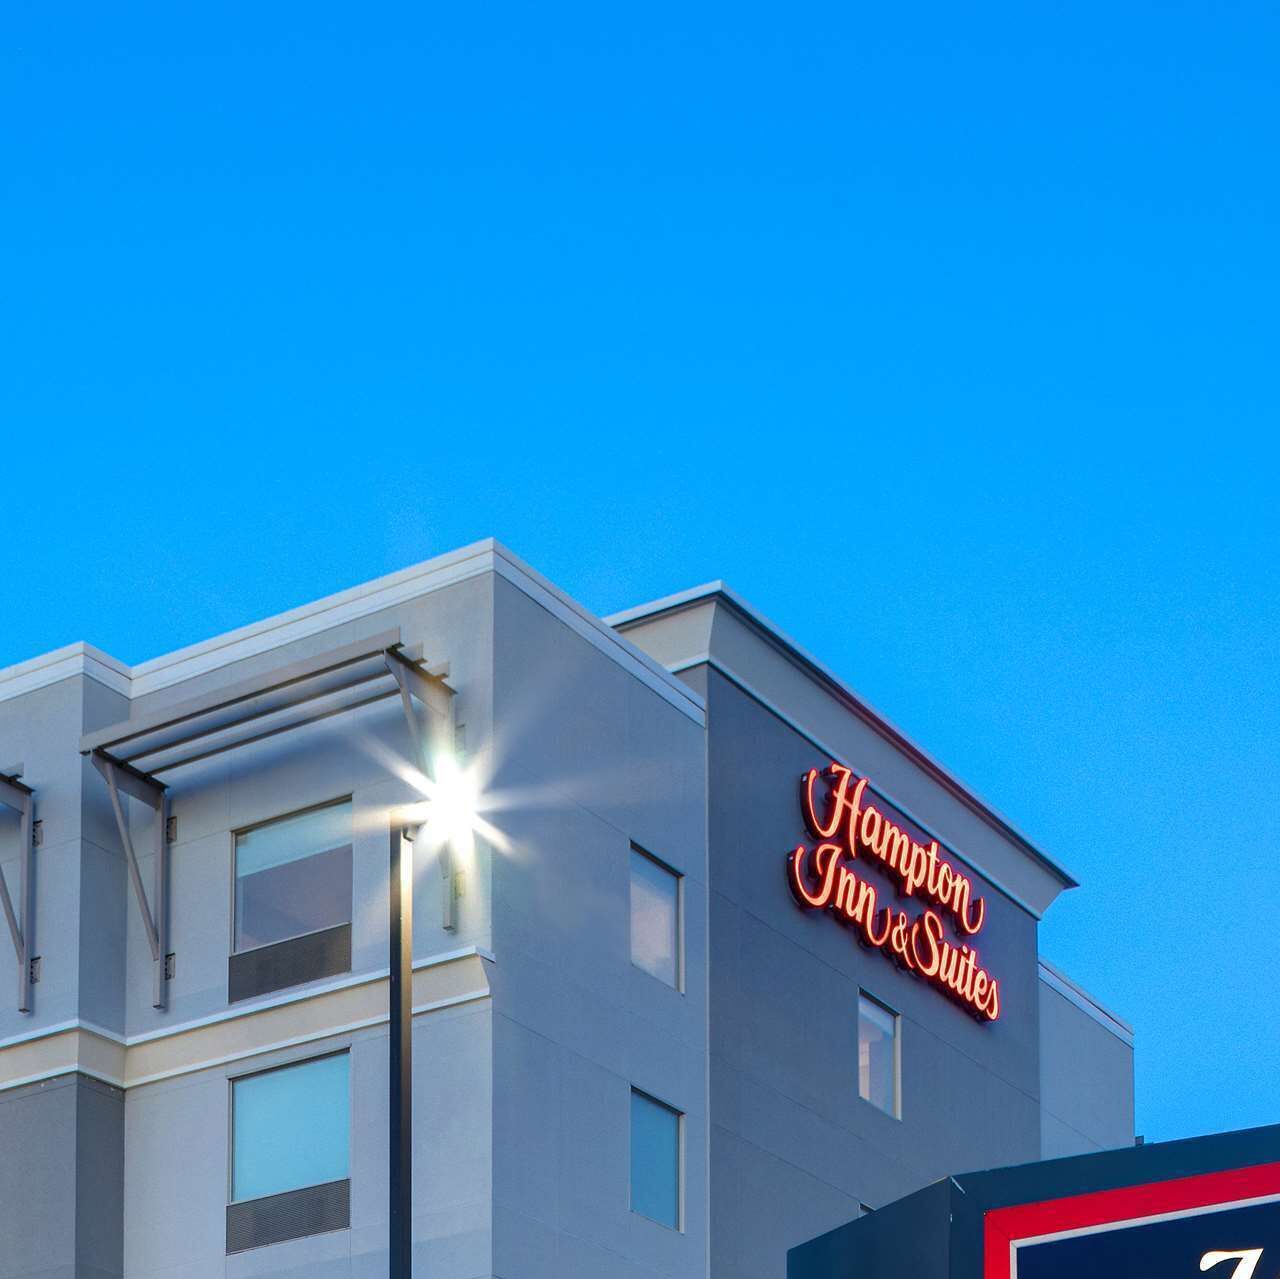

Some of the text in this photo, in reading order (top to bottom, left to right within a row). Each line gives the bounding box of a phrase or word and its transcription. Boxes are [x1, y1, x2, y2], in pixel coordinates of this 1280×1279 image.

[792, 842, 1000, 1021] Inn & Suites
[804, 761, 985, 935] Hampton
